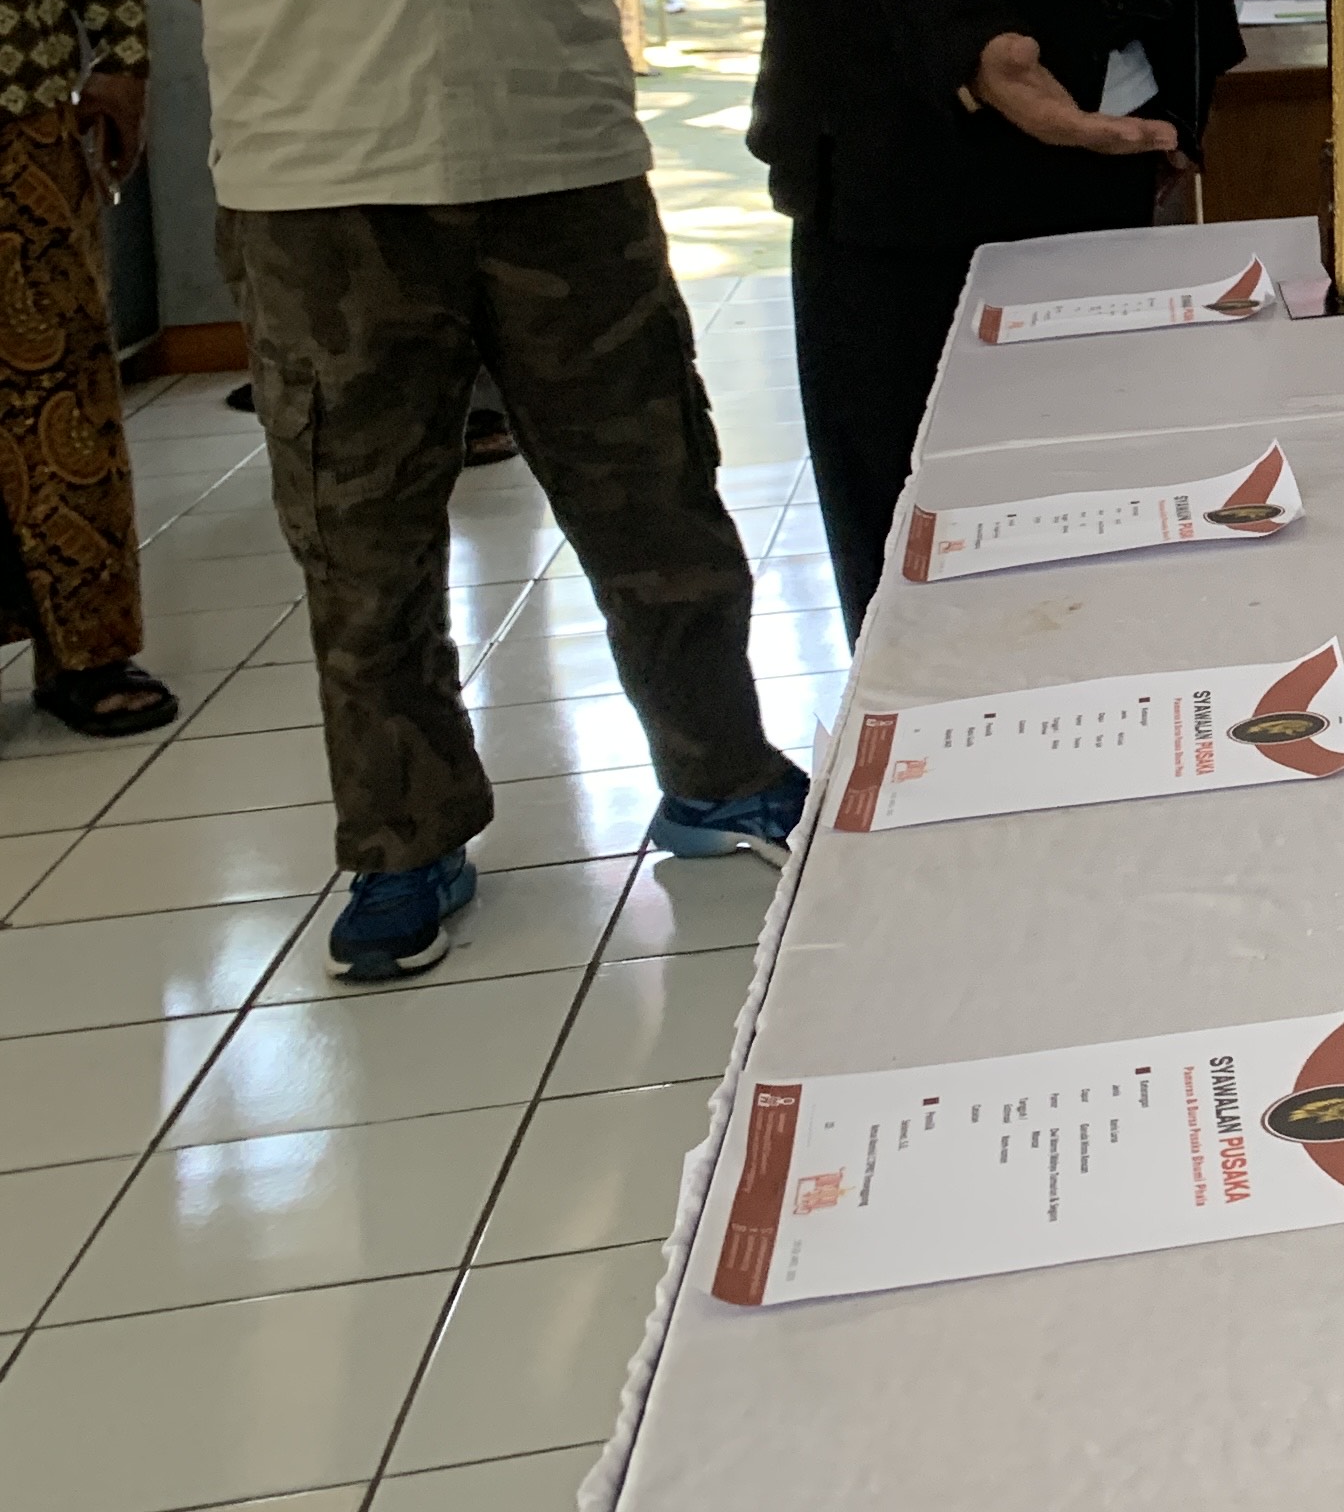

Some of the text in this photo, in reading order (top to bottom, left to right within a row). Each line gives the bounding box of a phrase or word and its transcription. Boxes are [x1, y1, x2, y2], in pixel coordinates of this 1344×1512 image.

[1193, 690, 1213, 740] SYAWALAN
[1184, 1066, 1195, 1097] Pameran
[1187, 1106, 1199, 1127] Bursa
[1209, 1055, 1251, 1204] SYAWALAN PUSAKA
[1189, 1128, 1201, 1153] Pusaka
